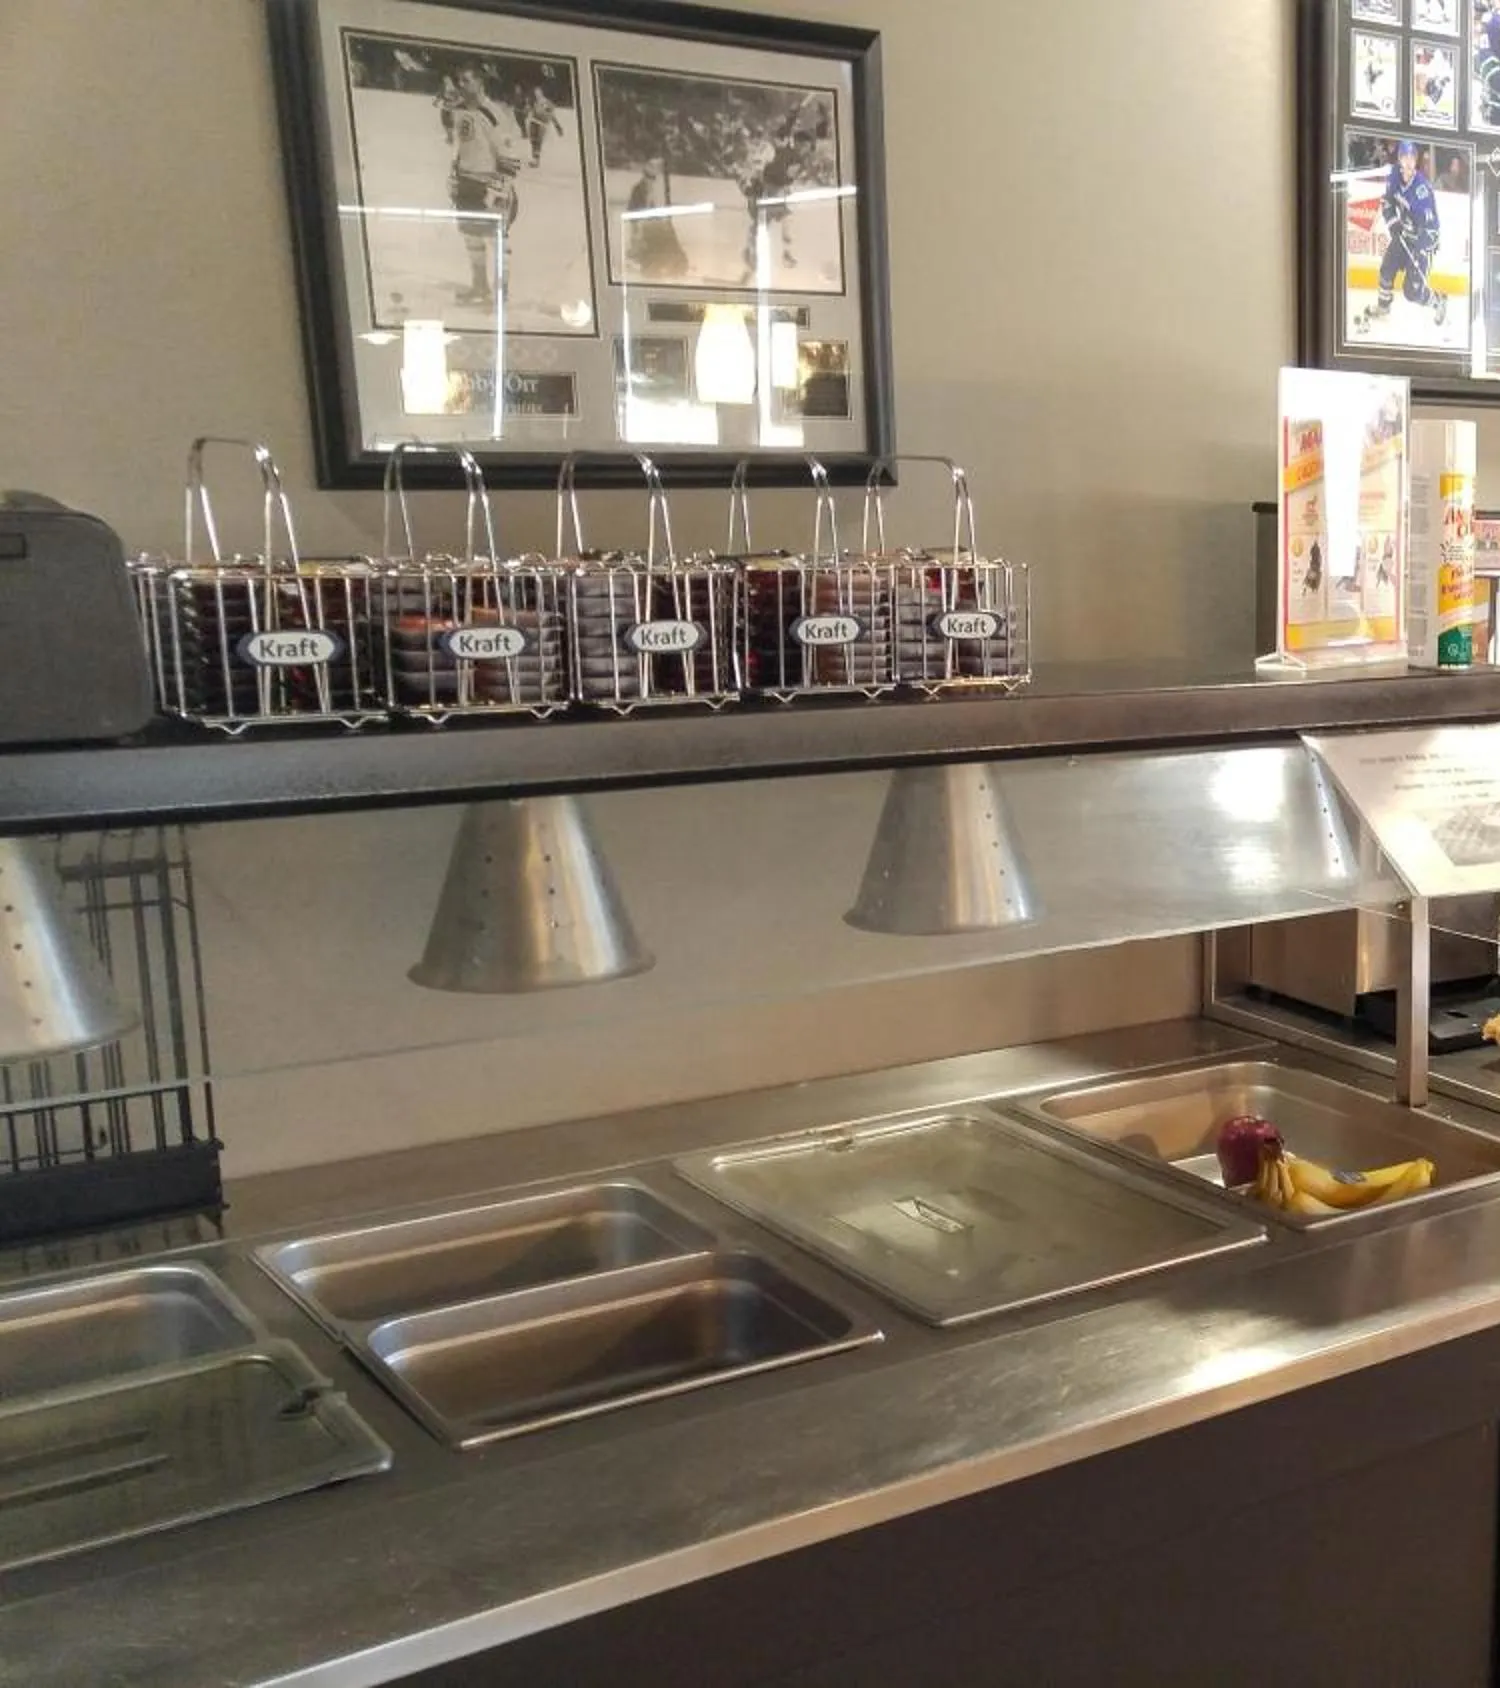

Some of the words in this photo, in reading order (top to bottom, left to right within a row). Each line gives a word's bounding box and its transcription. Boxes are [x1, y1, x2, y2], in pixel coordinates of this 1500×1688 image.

[804, 619, 848, 638] Kraft
[946, 616, 988, 635] Kraft
[458, 631, 512, 653] Kraft
[640, 626, 688, 646] Kraft
[258, 638, 320, 658] Kraft
